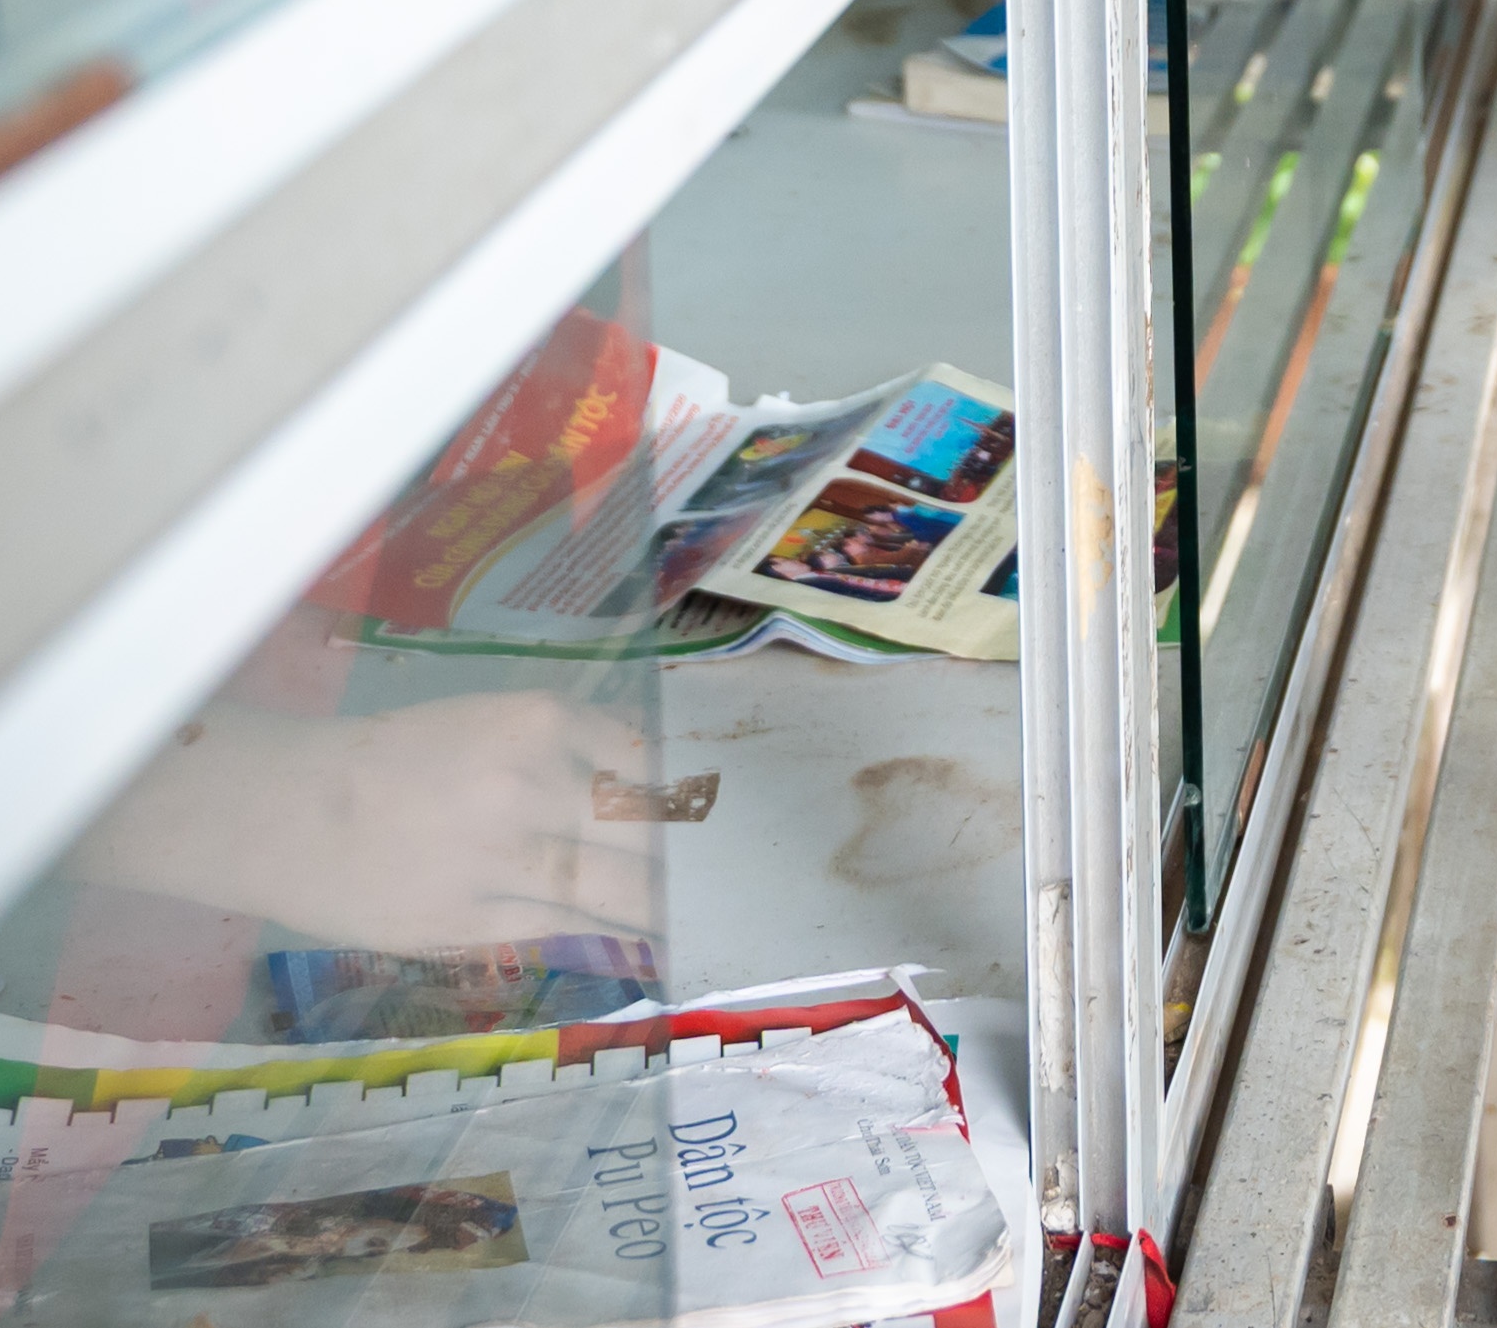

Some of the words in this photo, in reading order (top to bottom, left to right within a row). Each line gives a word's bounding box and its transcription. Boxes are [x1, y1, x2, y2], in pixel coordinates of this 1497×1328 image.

[587, 1137, 658, 1188] Pu
[667, 1109, 747, 1191] Dân
[602, 1192, 670, 1260] Peo
[683, 1196, 771, 1250] tộc
